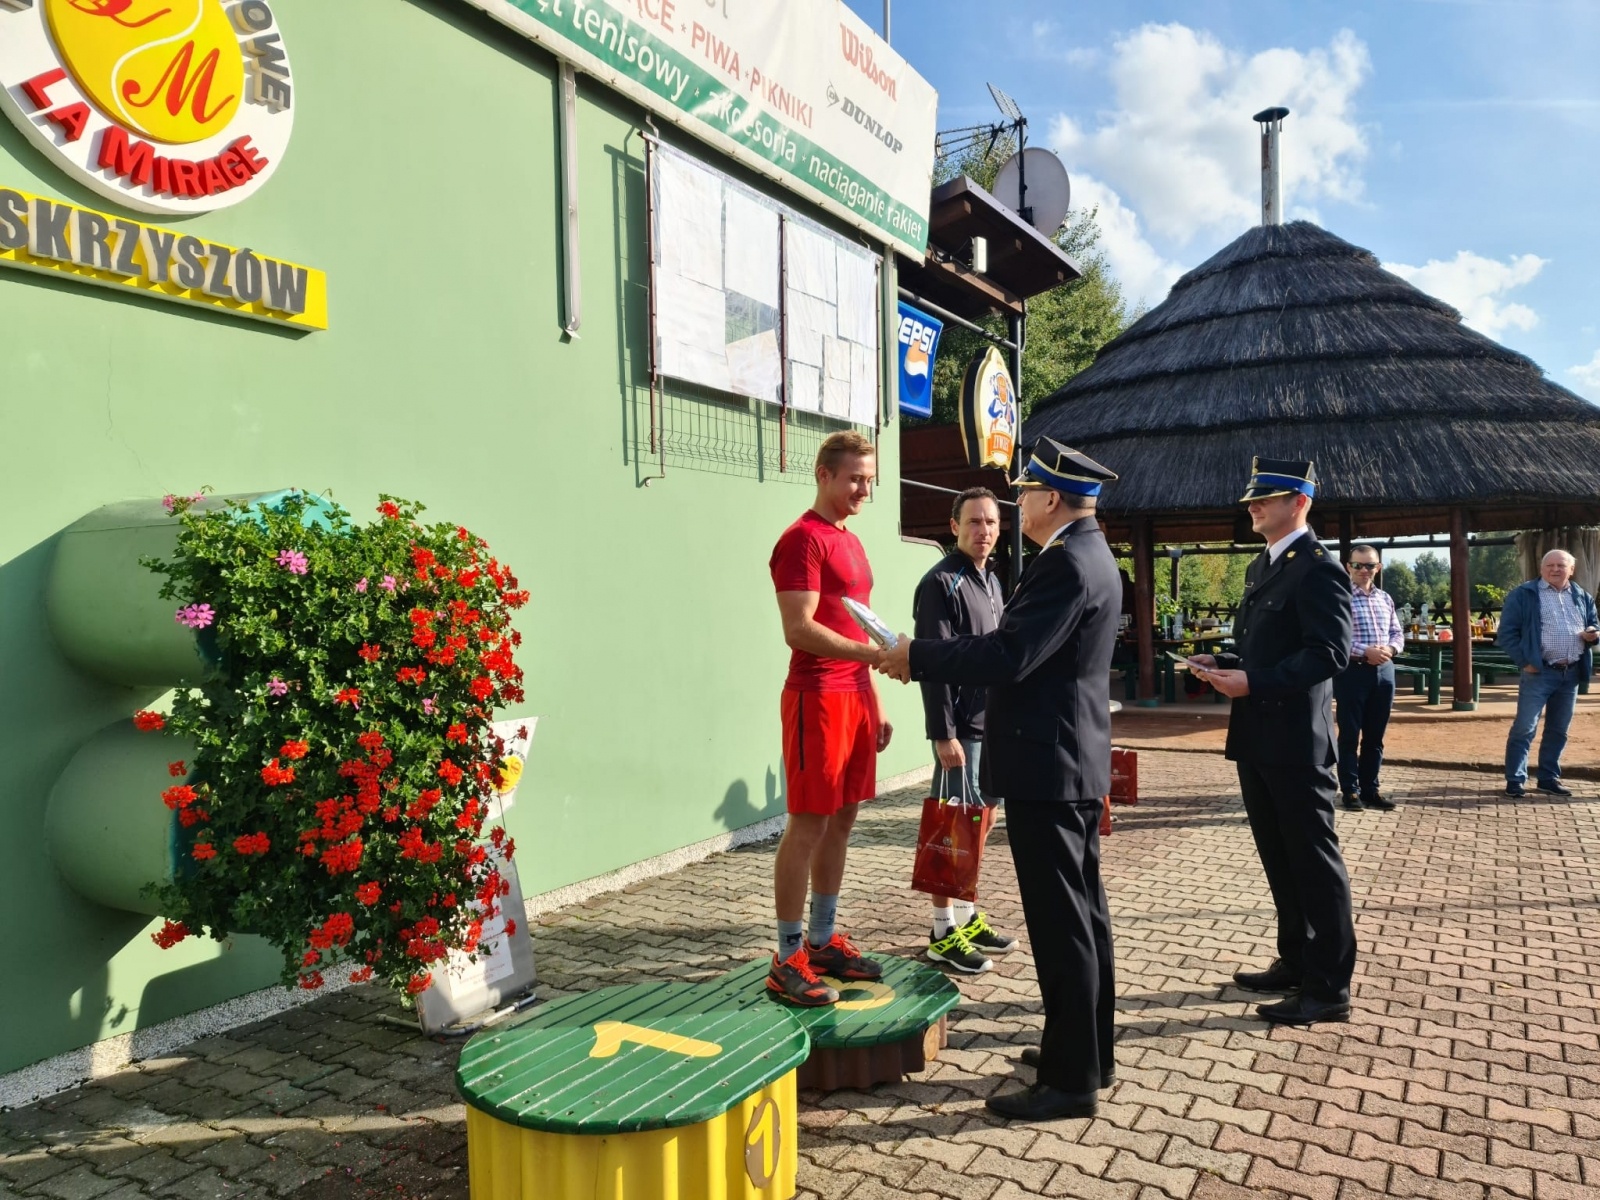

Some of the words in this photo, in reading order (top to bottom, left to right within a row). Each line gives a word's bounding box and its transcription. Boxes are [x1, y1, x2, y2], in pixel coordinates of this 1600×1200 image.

[691, 20, 740, 81] PIWA
[750, 67, 813, 129] PIKNIKI
[840, 22, 897, 102] Wilson
[20, 67, 91, 141] LA
[97, 125, 269, 199] MIRAGE
[572, 0, 690, 101] tenisowy
[808, 155, 885, 218] naciąganie
[887, 206, 922, 242] rakiet
[841, 96, 903, 154] DUNLOP
[0, 188, 308, 315] SKRZYSZÓW
[590, 1020, 723, 1058] 1
[748, 1101, 773, 1178] 1
